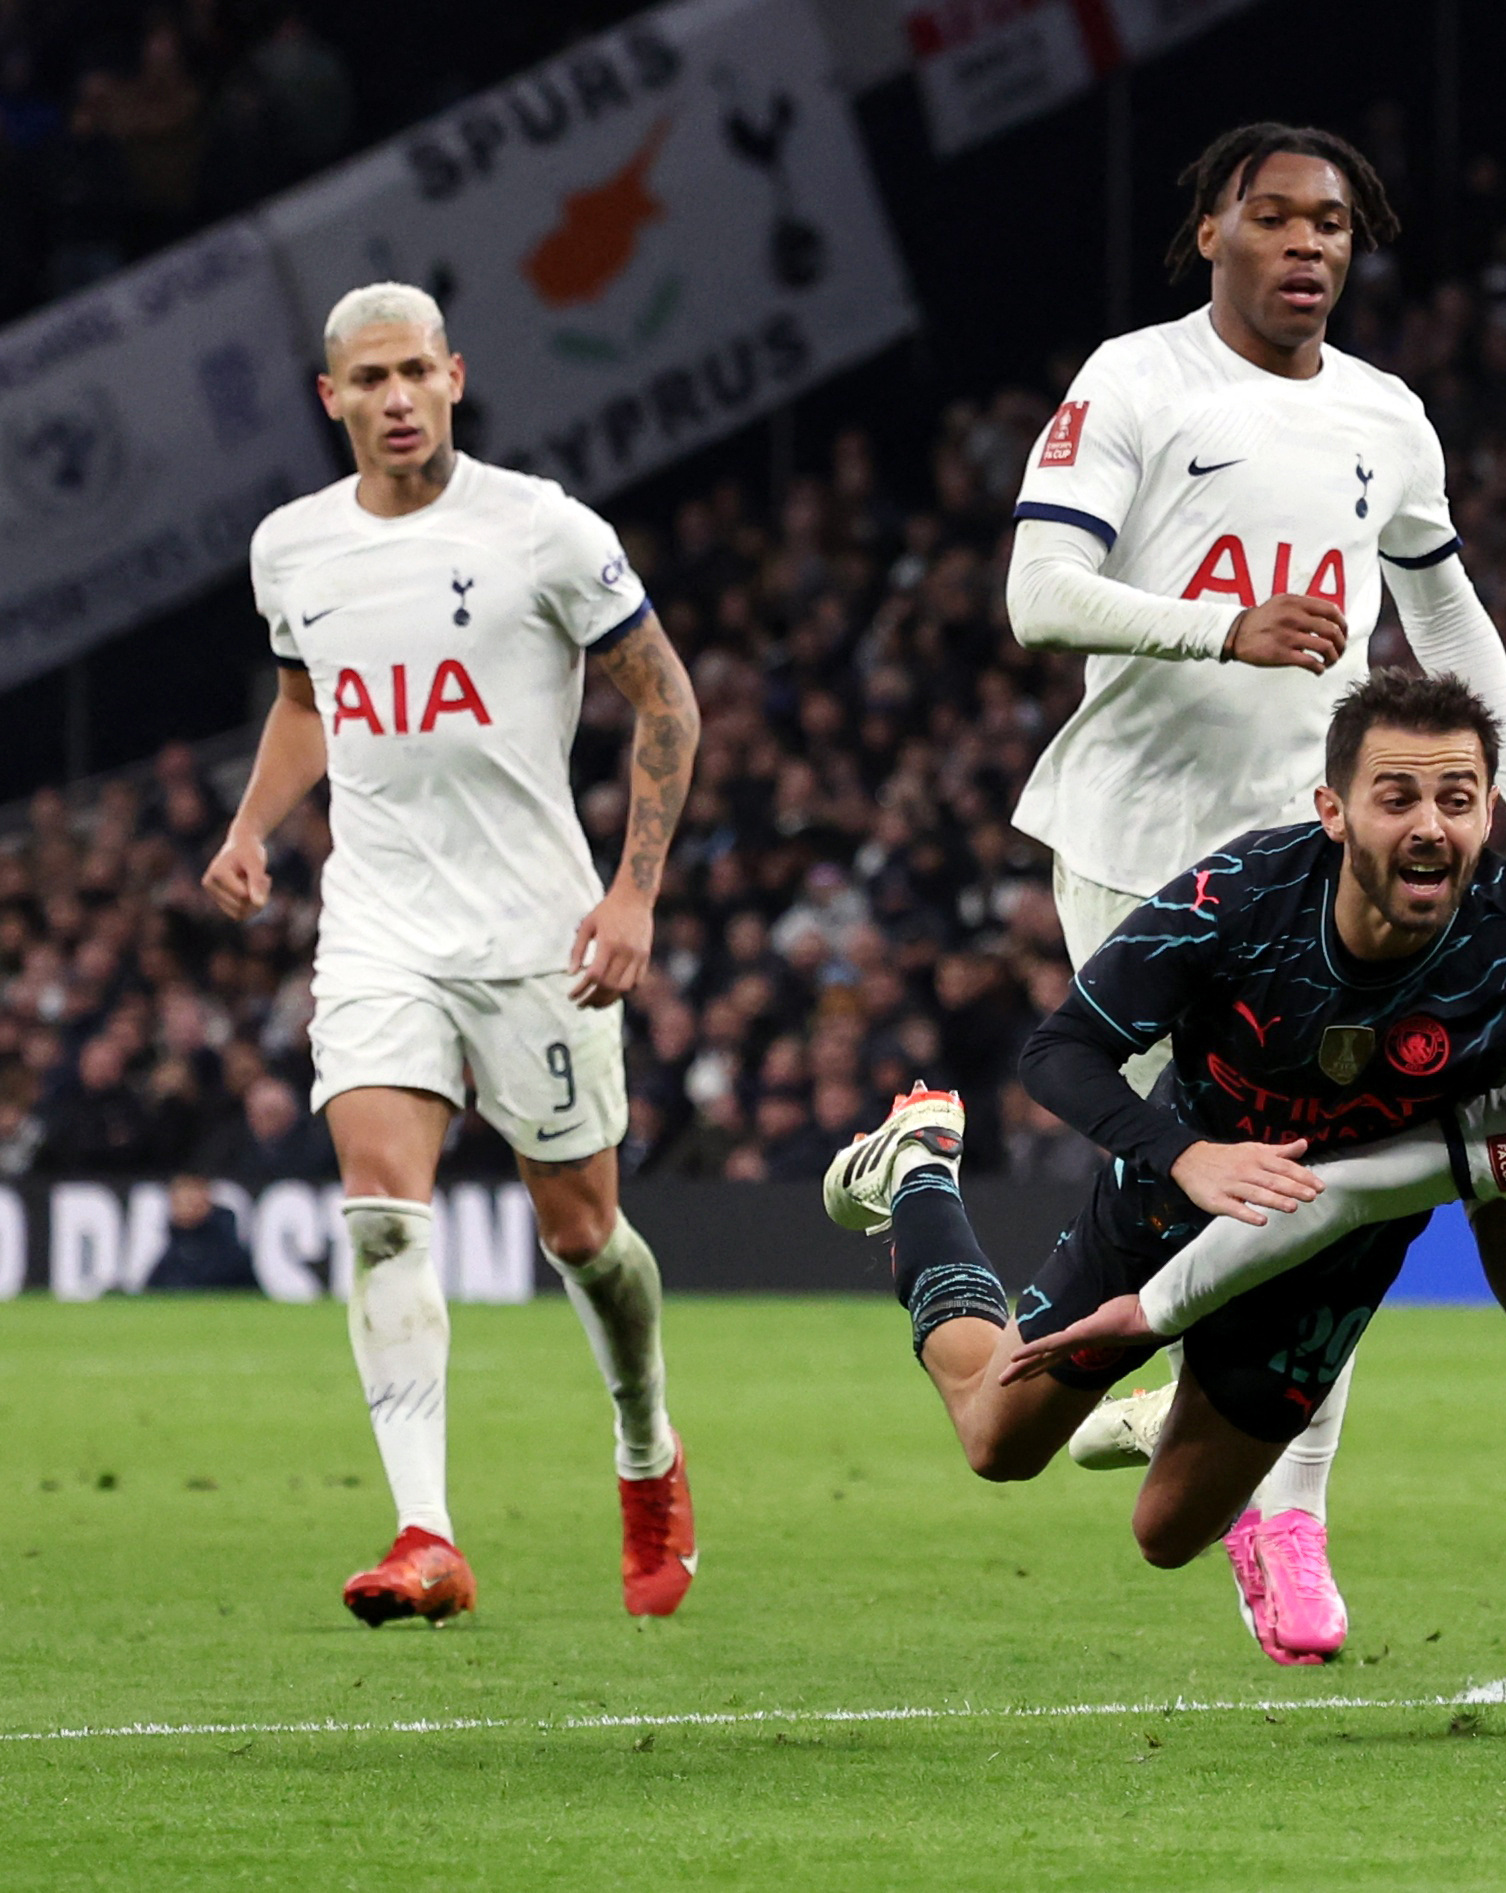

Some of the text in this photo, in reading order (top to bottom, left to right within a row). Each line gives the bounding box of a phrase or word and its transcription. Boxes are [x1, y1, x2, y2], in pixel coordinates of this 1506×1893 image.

[406, 36, 683, 202] SPURS
[1180, 534, 1346, 616] AIA
[333, 658, 493, 736] AIA
[546, 1042, 576, 1114] 9
[1268, 1304, 1371, 1383] 20
